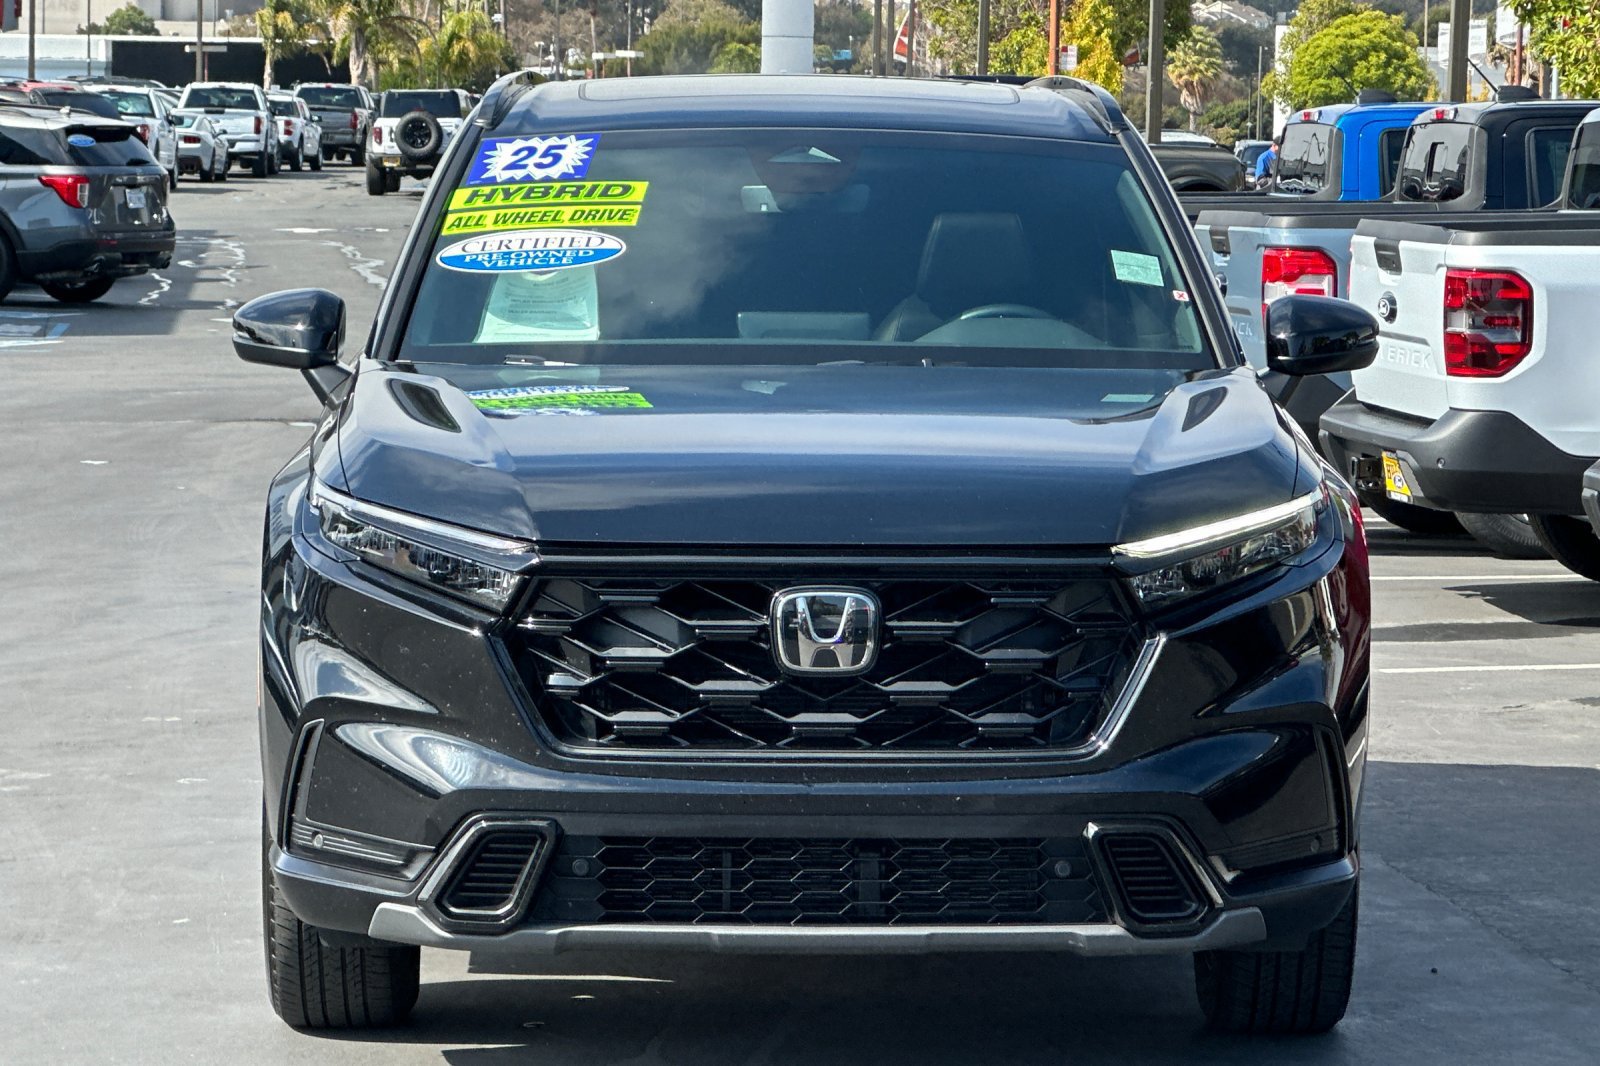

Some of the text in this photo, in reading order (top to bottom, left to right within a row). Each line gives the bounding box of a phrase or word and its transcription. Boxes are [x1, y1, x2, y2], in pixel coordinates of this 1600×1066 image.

[500, 144, 567, 171] 25
[464, 183, 634, 205] HYBRID
[448, 207, 636, 229] ALL WHEEL DRIVE
[461, 236, 605, 253] CERTIFIED
[464, 249, 594, 262] PRE-OWNED
[482, 256, 573, 268] VEHICLE
